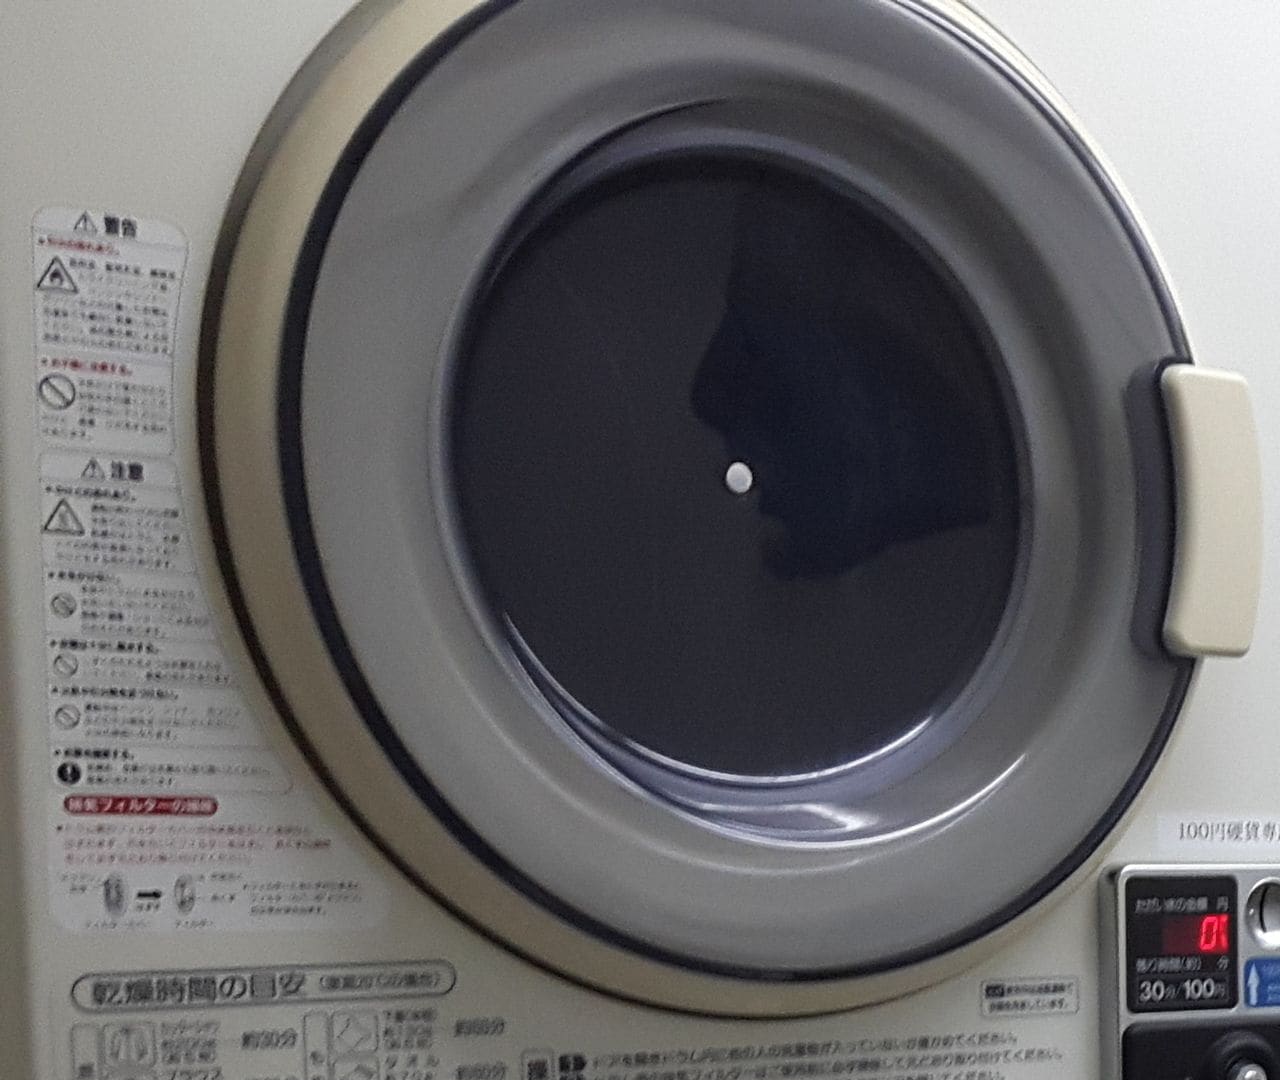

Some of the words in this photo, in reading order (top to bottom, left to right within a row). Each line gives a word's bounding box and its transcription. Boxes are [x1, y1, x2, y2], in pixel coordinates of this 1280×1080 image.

[93, 972, 305, 1006] 乾燥時間の目安
